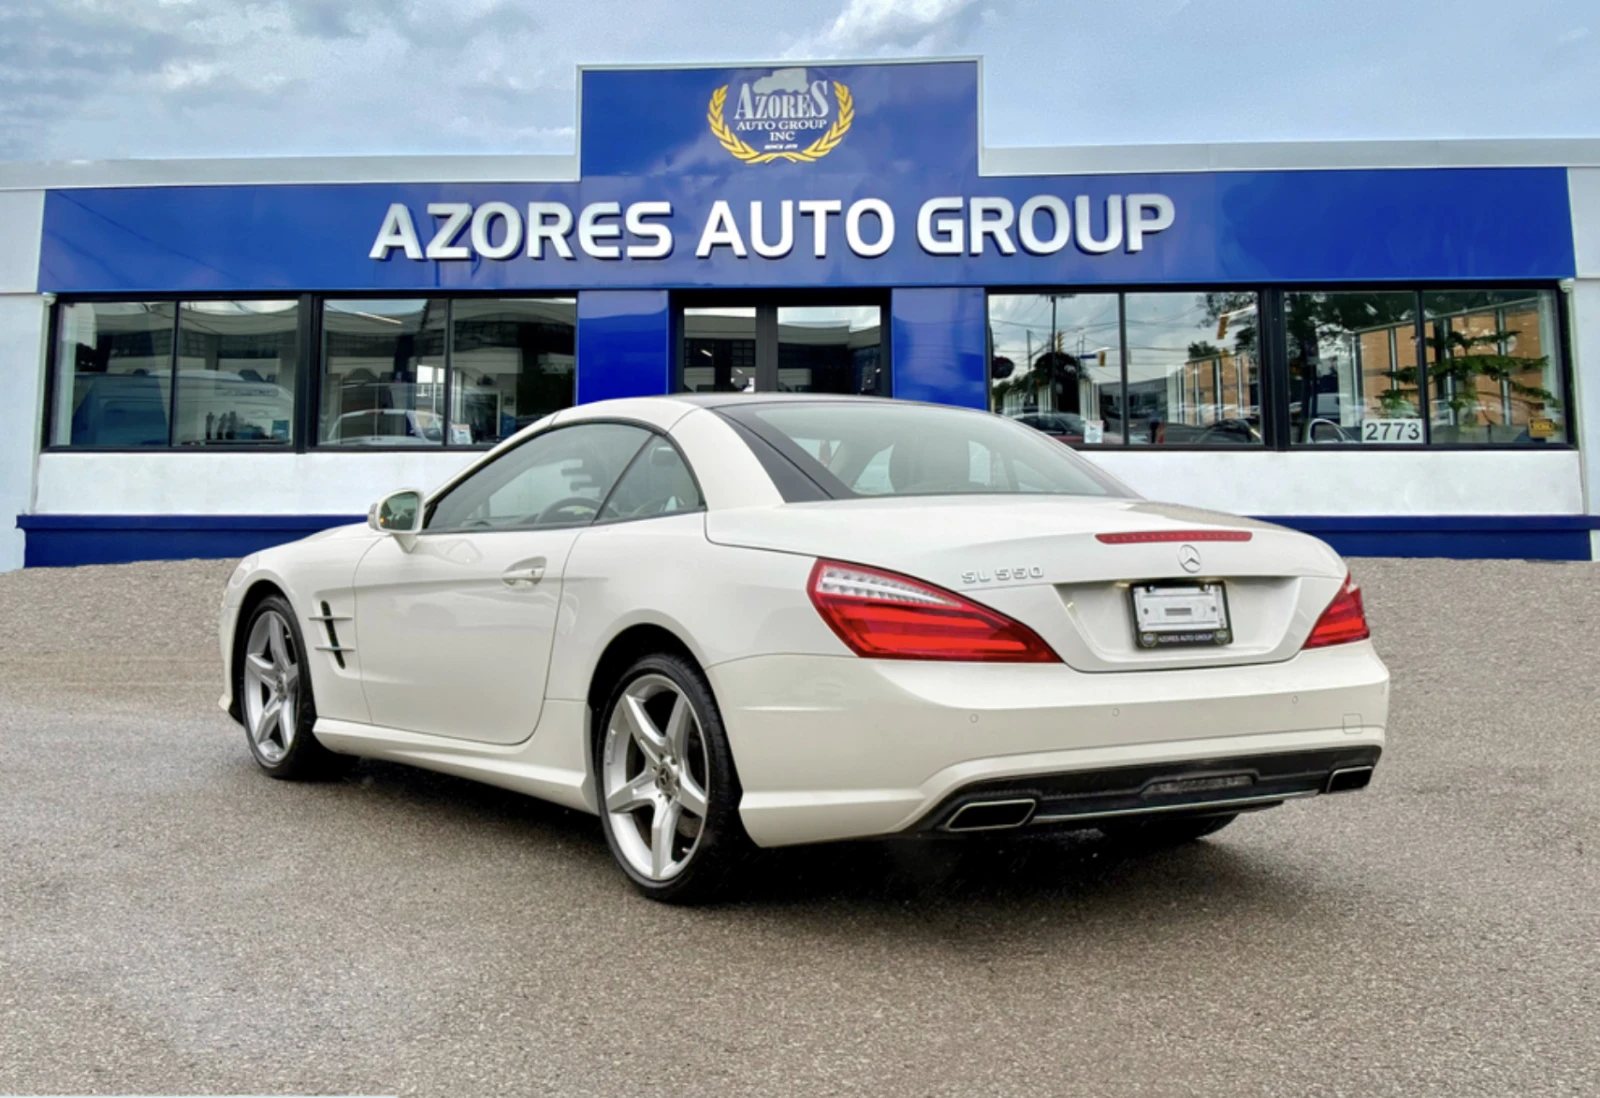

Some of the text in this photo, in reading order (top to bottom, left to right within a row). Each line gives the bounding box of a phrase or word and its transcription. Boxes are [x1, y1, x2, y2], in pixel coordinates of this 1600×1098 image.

[734, 80, 829, 119] AZORES
[737, 119, 827, 130] AUTO GROUP
[770, 132, 795, 141] INC
[368, 193, 1176, 261] AZORES AUTO GROUP
[1365, 422, 1420, 441] 2773
[961, 566, 1044, 584] SL 550
